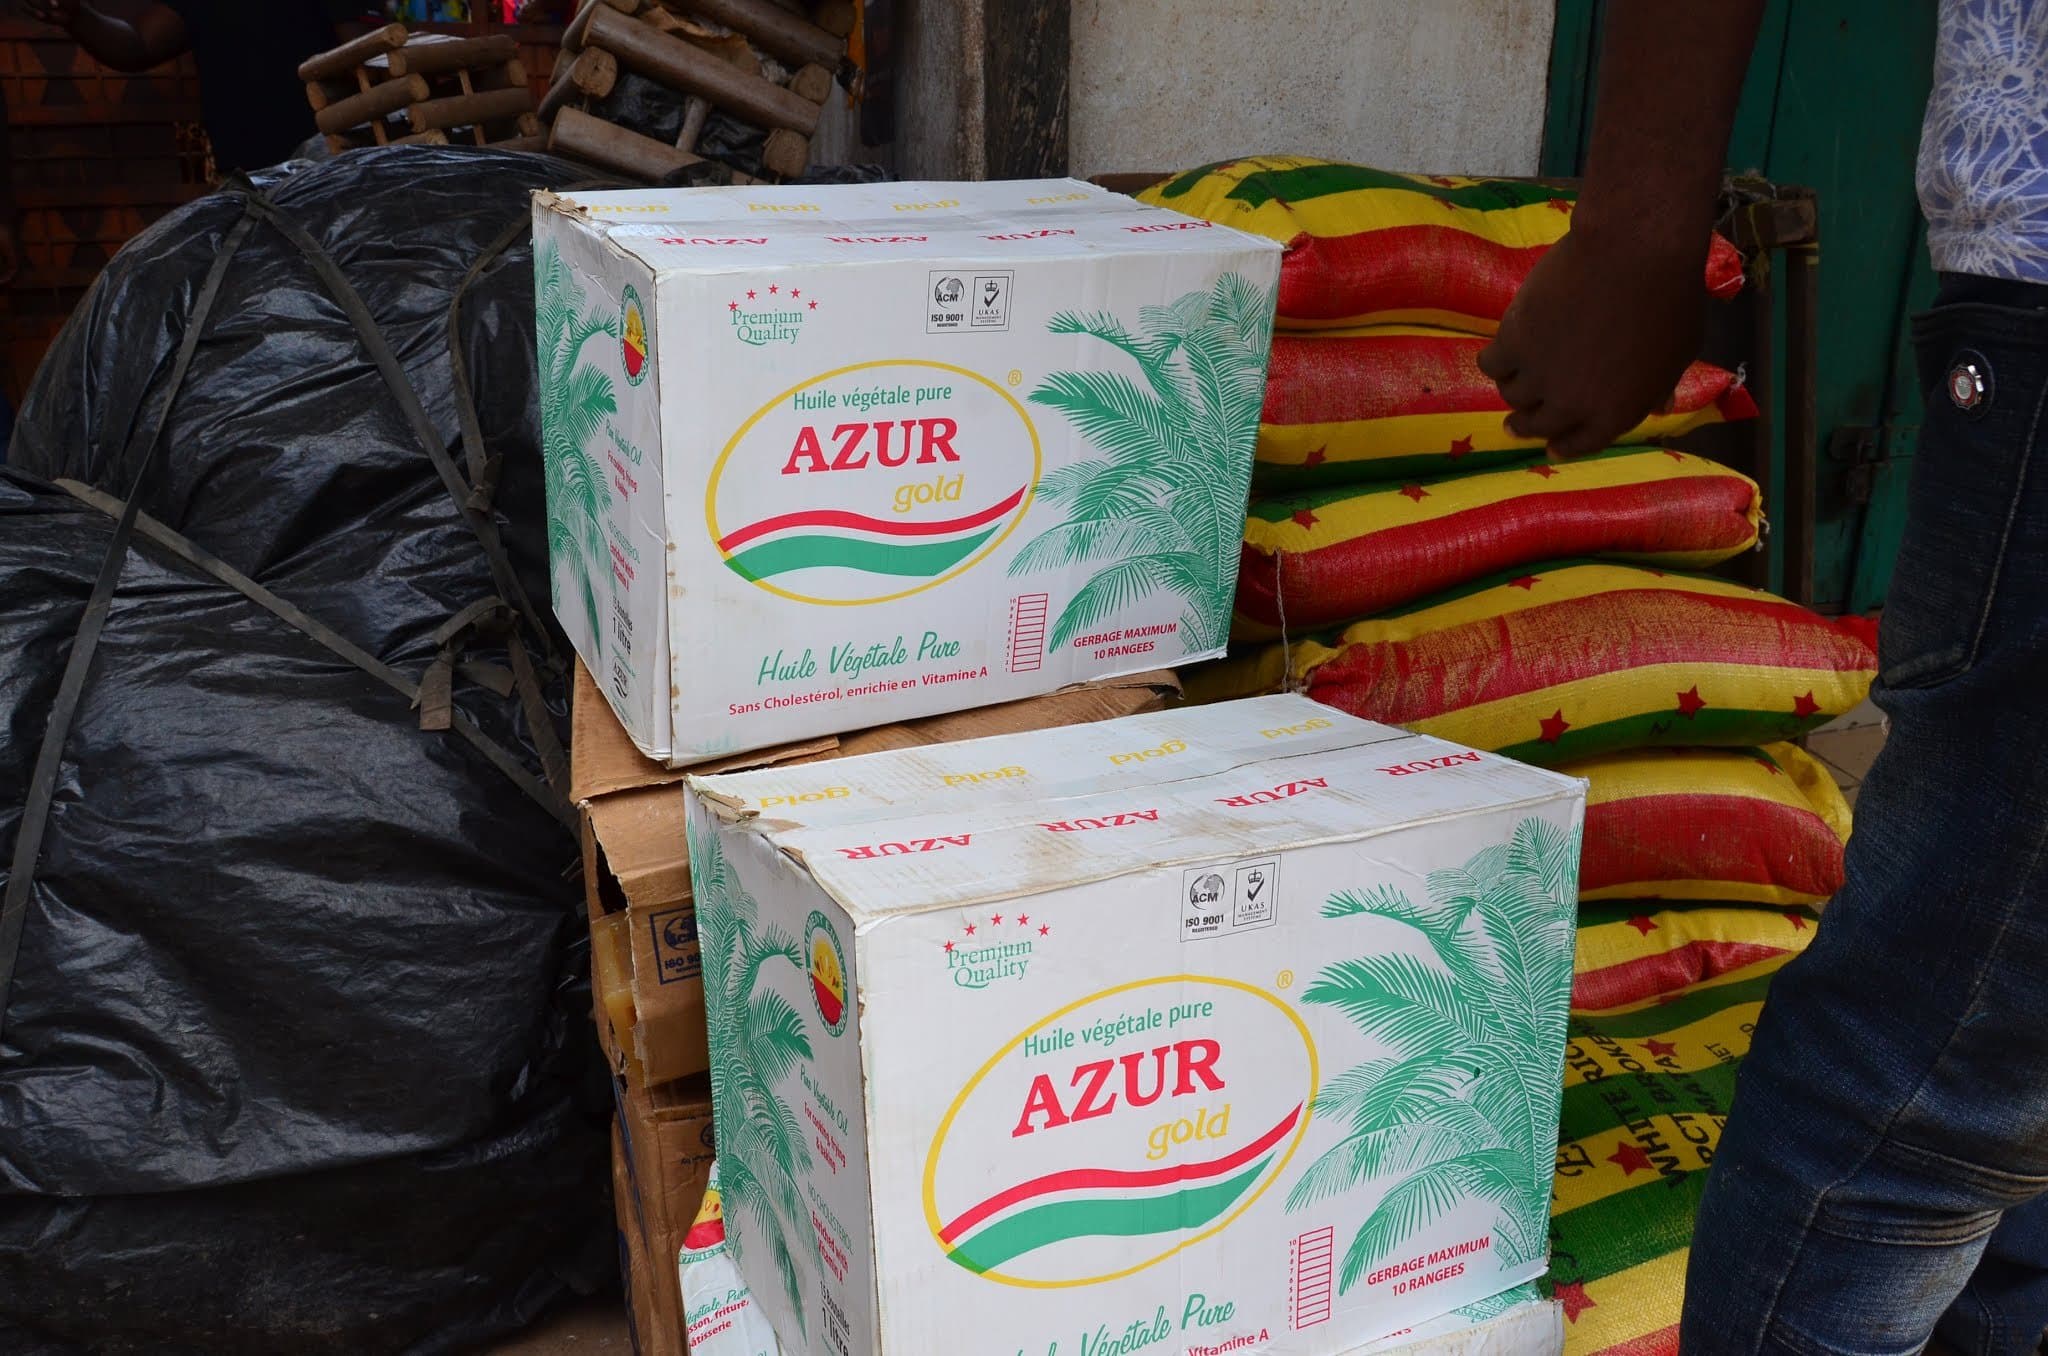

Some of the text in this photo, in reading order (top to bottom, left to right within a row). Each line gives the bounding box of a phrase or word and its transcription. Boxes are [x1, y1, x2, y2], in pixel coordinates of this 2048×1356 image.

[824, 235, 927, 243] AZUR
[979, 228, 1075, 241] AZUR
[1122, 219, 1212, 234] AZUR
[656, 237, 768, 245] AZUR
[937, 293, 959, 303] ACM
[731, 308, 803, 326] Premium
[931, 313, 964, 322] ISO 9001
[737, 324, 800, 346] Quality
[794, 384, 952, 412] Huile végétale pure
[781, 417, 960, 475] AZUR
[892, 473, 965, 513] gold
[1073, 622, 1177, 648] GERBAGE MAXIMUM
[757, 631, 960, 686] Huile Végétale Pure
[1094, 641, 1155, 660] 10 RANGEES
[729, 666, 988, 716] Sans Cholestérol, enrichie en Vitamine A
[1259, 718, 1333, 740] gold
[1109, 738, 1188, 766] gold
[1375, 751, 1482, 777] AZUR
[943, 766, 1028, 787] gold
[760, 785, 850, 808] gold
[1214, 777, 1328, 808] AZUR
[1037, 809, 1160, 832] AZUR
[835, 833, 972, 860] AZUR
[1192, 892, 1218, 904] ACM
[1185, 914, 1224, 928] ISO 9001
[947, 940, 1032, 970] Premium
[954, 959, 1029, 989] Quality
[1024, 1001, 1213, 1058] Huile végétale pure
[1566, 1036, 1612, 1084] RIC
[1011, 1038, 1226, 1138] AZUR
[1146, 1103, 1232, 1161] gold
[1602, 1086, 1688, 1188] WHITE
[1367, 1235, 1489, 1286] GERBAGE MAXIMUM
[1392, 1262, 1465, 1297] 10 RANGEES
[686, 1297, 721, 1325] égétale
[687, 1299, 750, 1335] sson, friture,
[822, 1306, 827, 1329] 1
[1181, 1293, 1236, 1330] Pure
[688, 1320, 732, 1348] âtisserie
[1258, 1328, 1270, 1342] A
